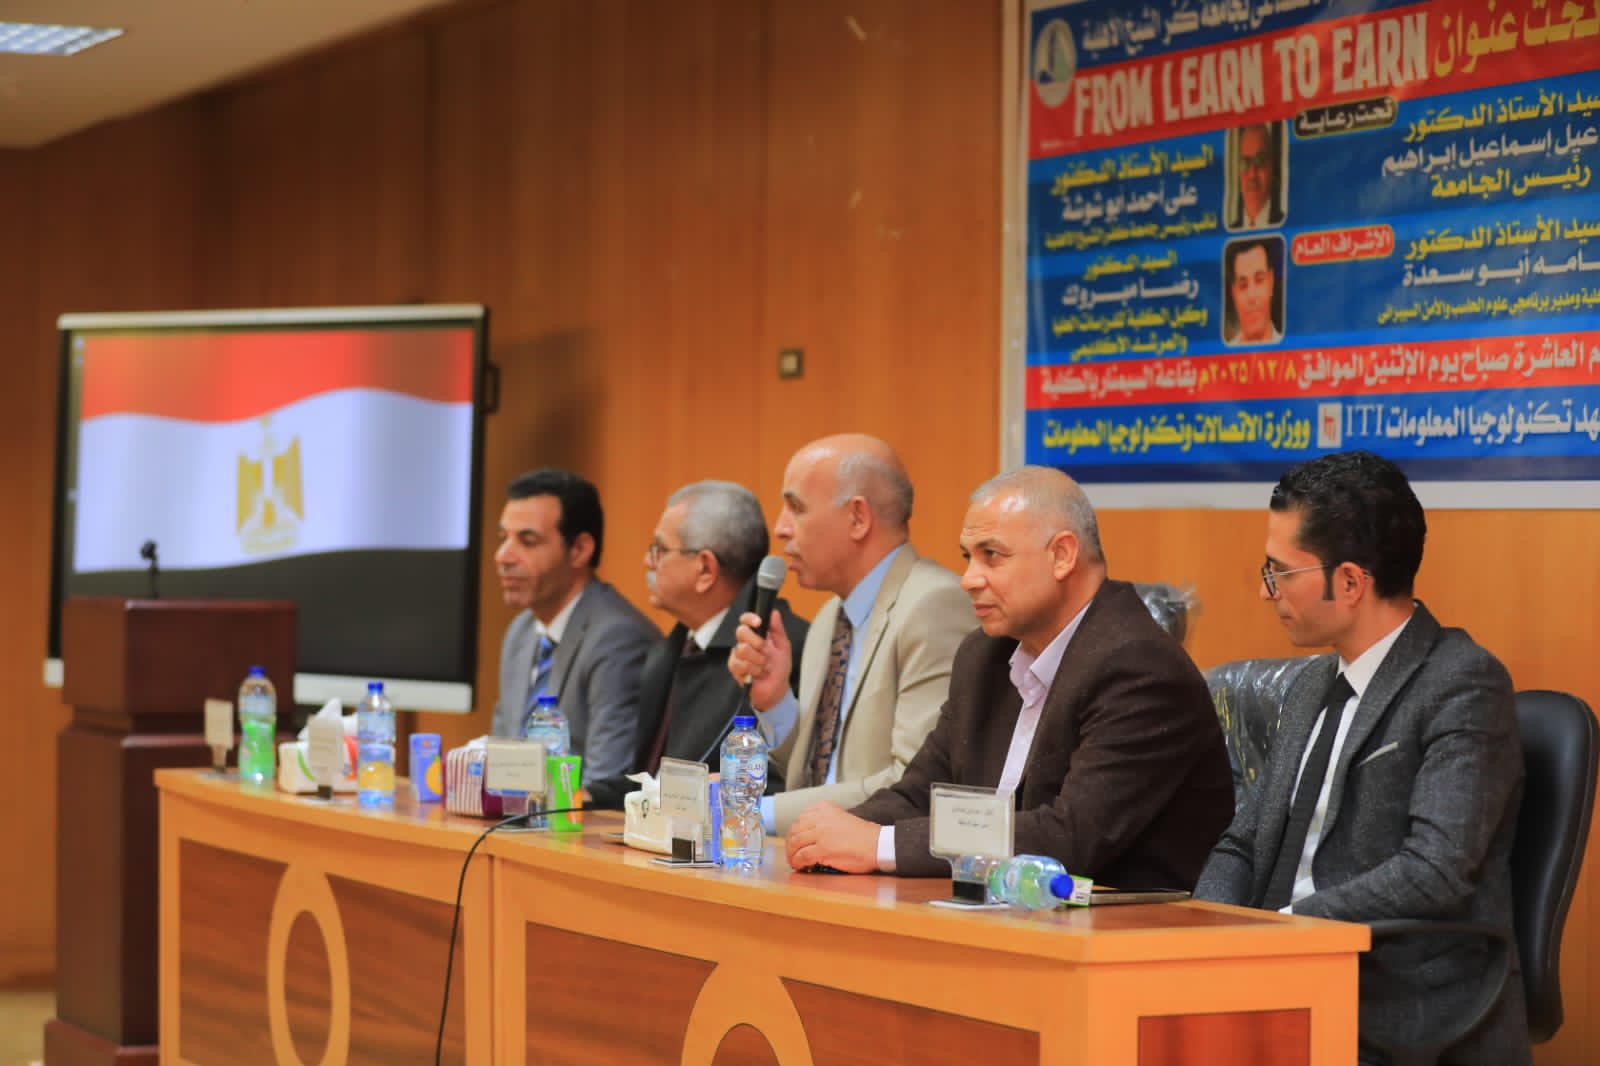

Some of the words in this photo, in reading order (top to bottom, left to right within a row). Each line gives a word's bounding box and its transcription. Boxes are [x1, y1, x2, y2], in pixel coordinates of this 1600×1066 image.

[1433, 0, 1519, 77] عنوان
[1073, 64, 1154, 137] FROM
[1162, 42, 1265, 122] LEARN
[1273, 33, 1320, 104] TO
[1331, 12, 1429, 94] EARN
[1299, 109, 1354, 133] رعاية
[1354, 98, 1393, 121] تحت
[1402, 103, 1493, 142] الدكتور
[1496, 88, 1564, 124] الأستاذ
[1170, 144, 1214, 177] السيد
[1382, 144, 1456, 176] إبراهيم
[1459, 129, 1552, 169] إسماعيل
[1431, 166, 1511, 199] الجامعة
[1512, 154, 1592, 196] رئيس
[1404, 224, 1492, 260] الدكتور
[1494, 213, 1561, 246] الأستاذ
[1140, 248, 1177, 274] السيد
[1295, 236, 1331, 260] العام
[1140, 269, 1199, 300] رضا
[1402, 263, 1475, 287] سعدة
[1061, 283, 1139, 311] مبروك
[1298, 350, 1363, 390] الموافق
[1427, 354, 1460, 384] يوم
[1461, 344, 1510, 383] صباح
[1513, 337, 1585, 378] العاشرة
[1041, 365, 1098, 401] بالكلية
[1154, 359, 1198, 395] بقاعة
[1042, 418, 1107, 455] المعلومات
[1107, 411, 1194, 453] وتكنولوجيا
[1193, 410, 1264, 444] الاتصالات
[1264, 409, 1312, 450] ووزارة
[1346, 403, 1384, 437] ITI
[1385, 403, 1466, 446] المعلومات
[1468, 398, 1574, 444] تكنولوجيا
